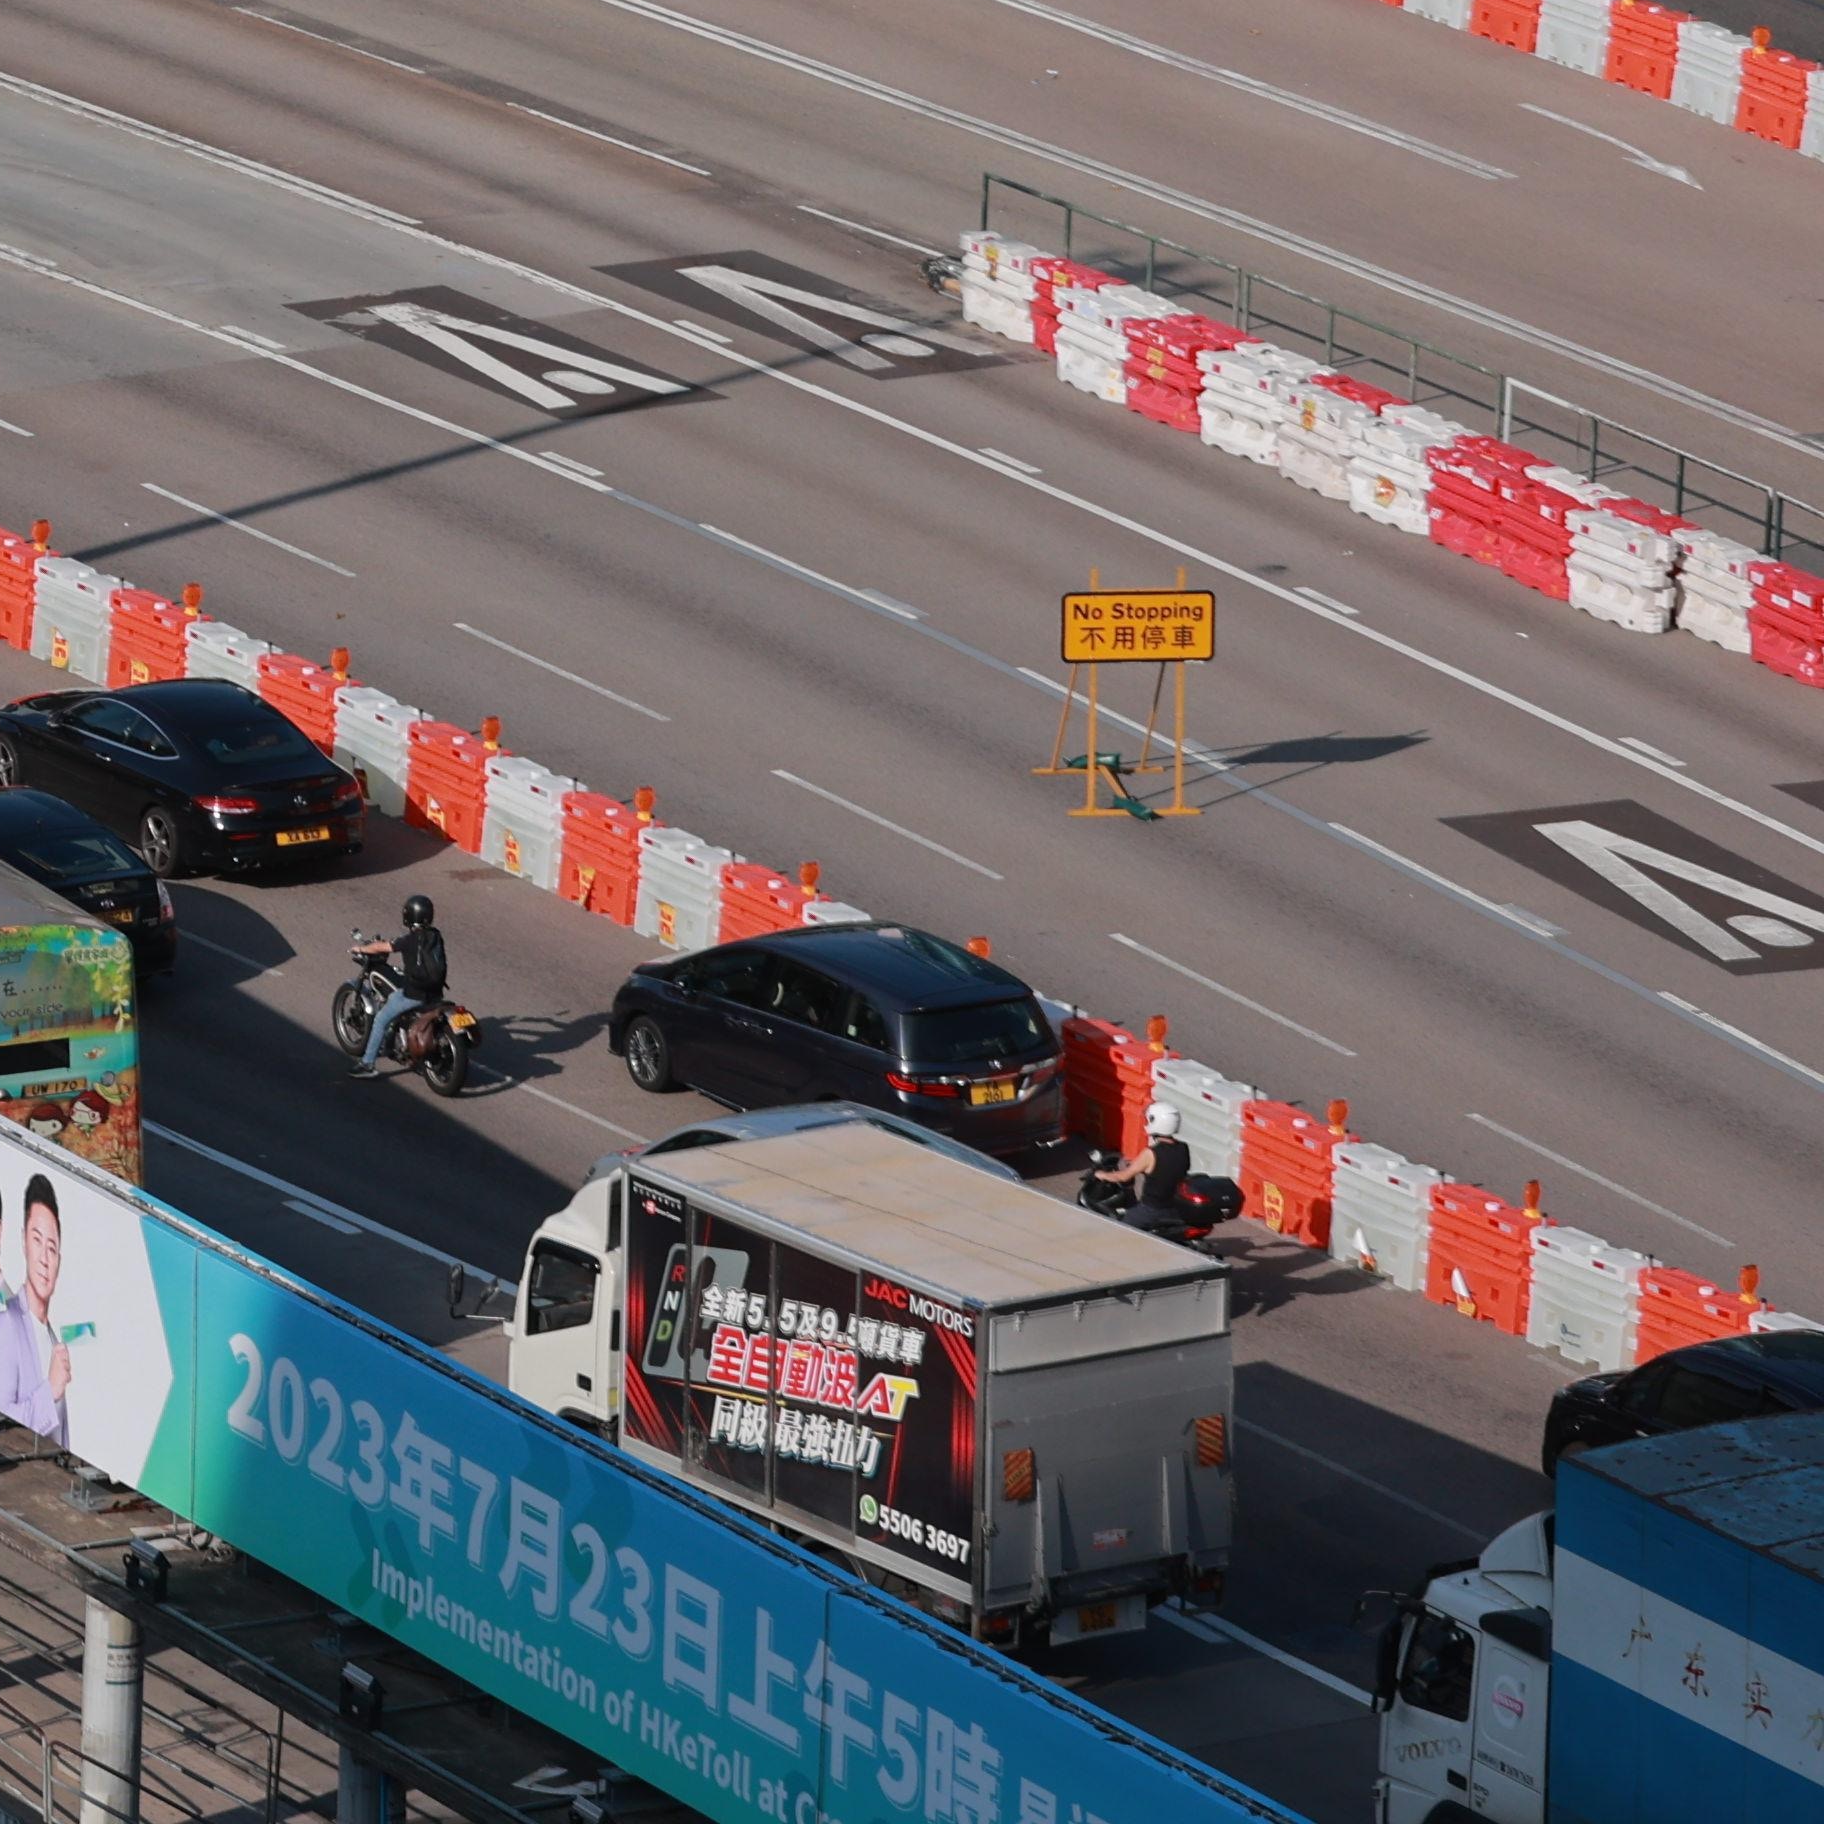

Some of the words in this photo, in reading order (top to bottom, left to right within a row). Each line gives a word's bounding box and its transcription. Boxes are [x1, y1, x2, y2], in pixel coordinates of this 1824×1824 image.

[1073, 604, 1102, 621] No
[1111, 601, 1204, 623] Stopping
[1080, 625, 1196, 651] 不用停車
[671, 1264, 687, 1283] R
[664, 1292, 681, 1313] N
[864, 1279, 908, 1309] JAC
[908, 1293, 974, 1338] MOTORS
[878, 1503, 923, 1545] 5506
[924, 1523, 970, 1564] 3697
[225, 1331, 1004, 1822] 2023年7月23日上午5時
[371, 1546, 598, 1715] Implementation
[603, 1687, 635, 1732] of
[639, 1699, 751, 1802] HKeToll
